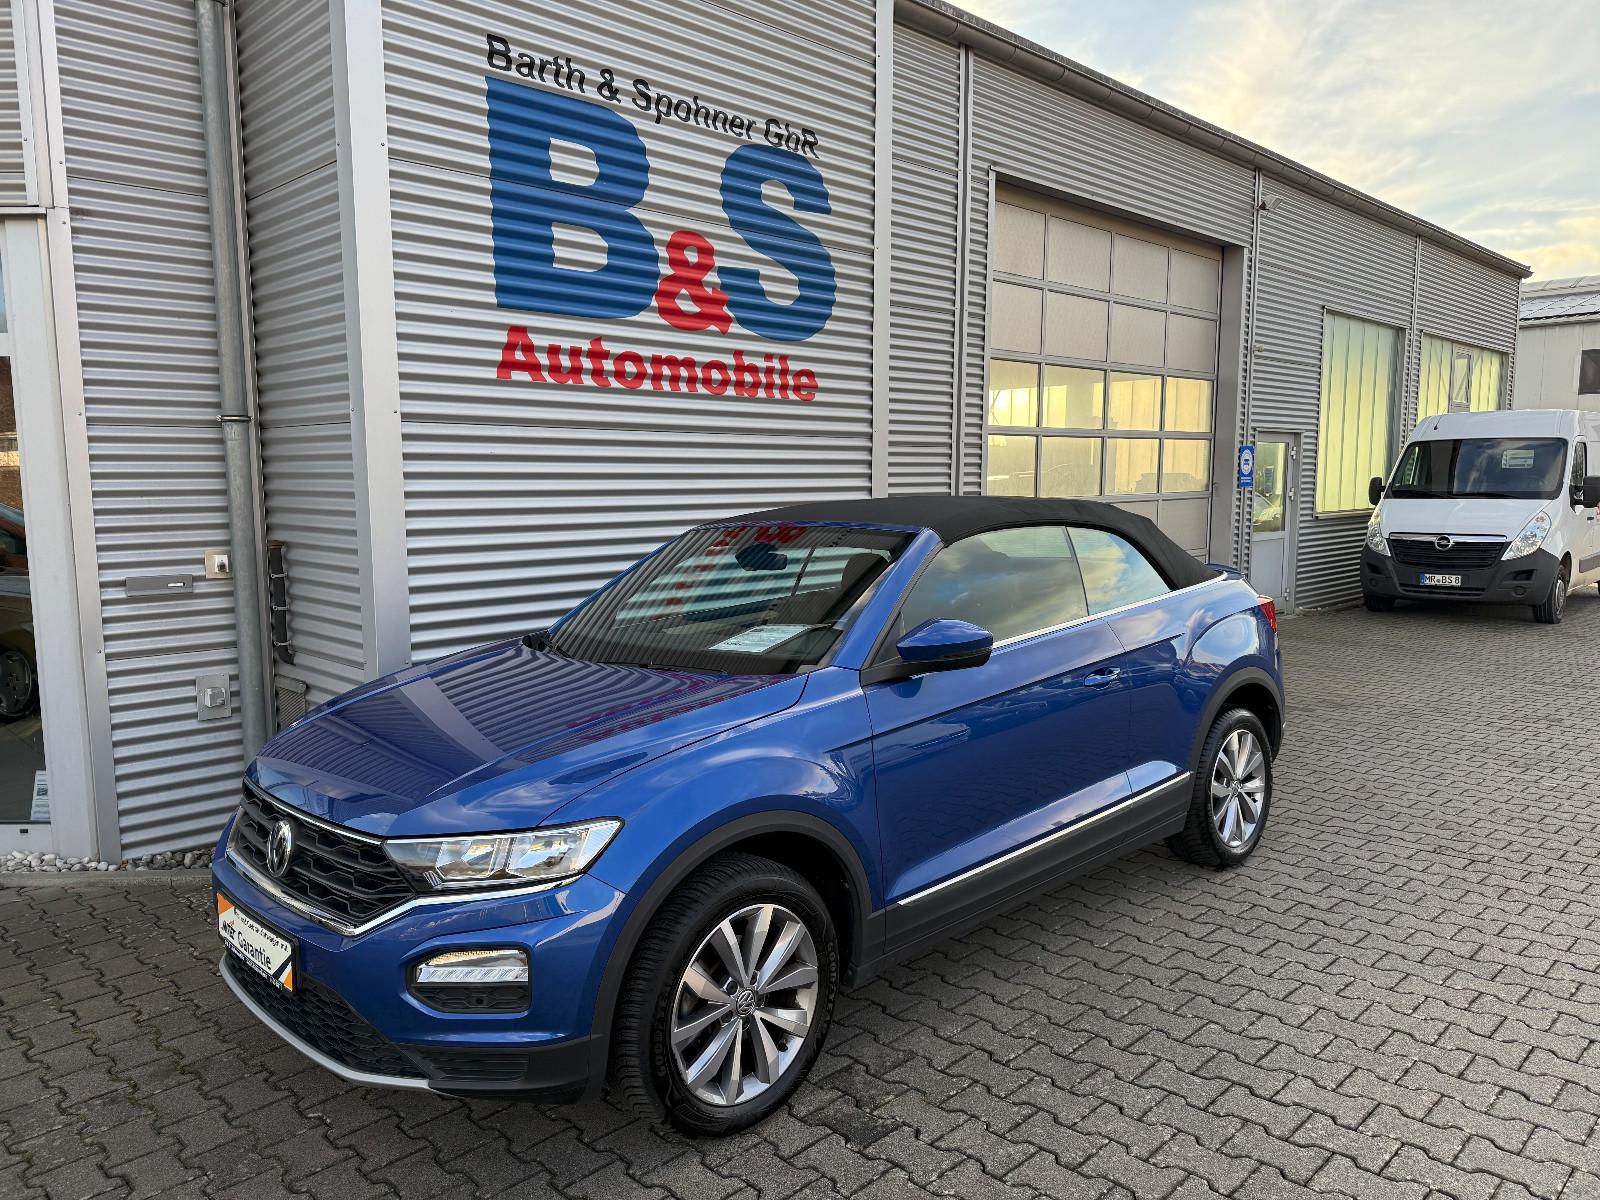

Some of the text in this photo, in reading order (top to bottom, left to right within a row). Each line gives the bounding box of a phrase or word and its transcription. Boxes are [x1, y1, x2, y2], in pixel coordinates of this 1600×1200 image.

[486, 34, 820, 159] Barth & Spohner GbR
[496, 325, 819, 401] Automobile
[1424, 575, 1436, 584] MR
[1441, 575, 1453, 584] BS
[237, 930, 272, 971] Garantie
